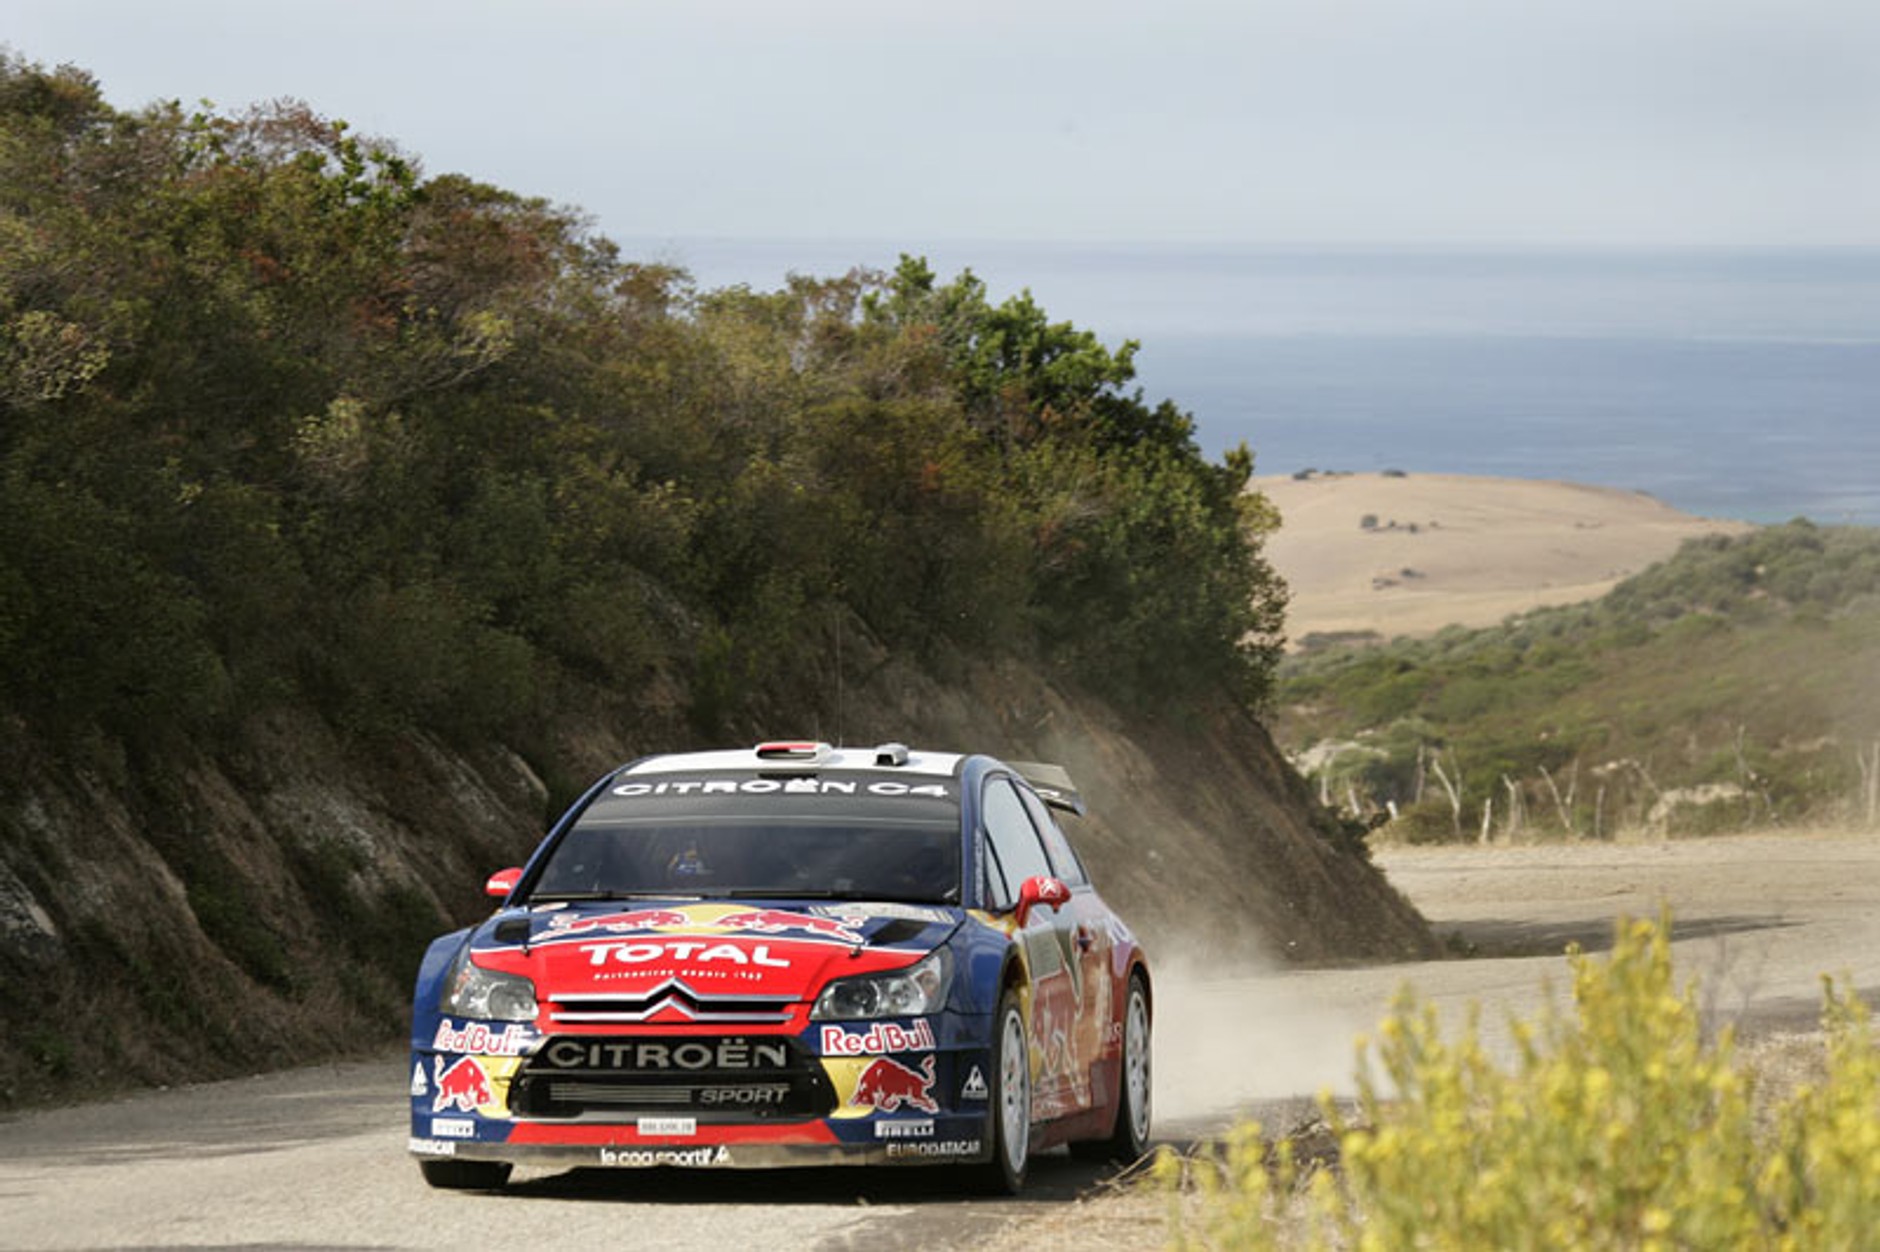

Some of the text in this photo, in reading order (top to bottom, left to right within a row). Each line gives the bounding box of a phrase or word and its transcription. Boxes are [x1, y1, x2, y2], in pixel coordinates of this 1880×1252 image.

[867, 782, 948, 797] C4
[579, 942, 790, 968] TOTAL
[821, 1018, 936, 1056] Red Bull
[547, 1038, 787, 1068] CITROËN
[700, 1082, 791, 1103] SPORT
[600, 1148, 617, 1166] le
